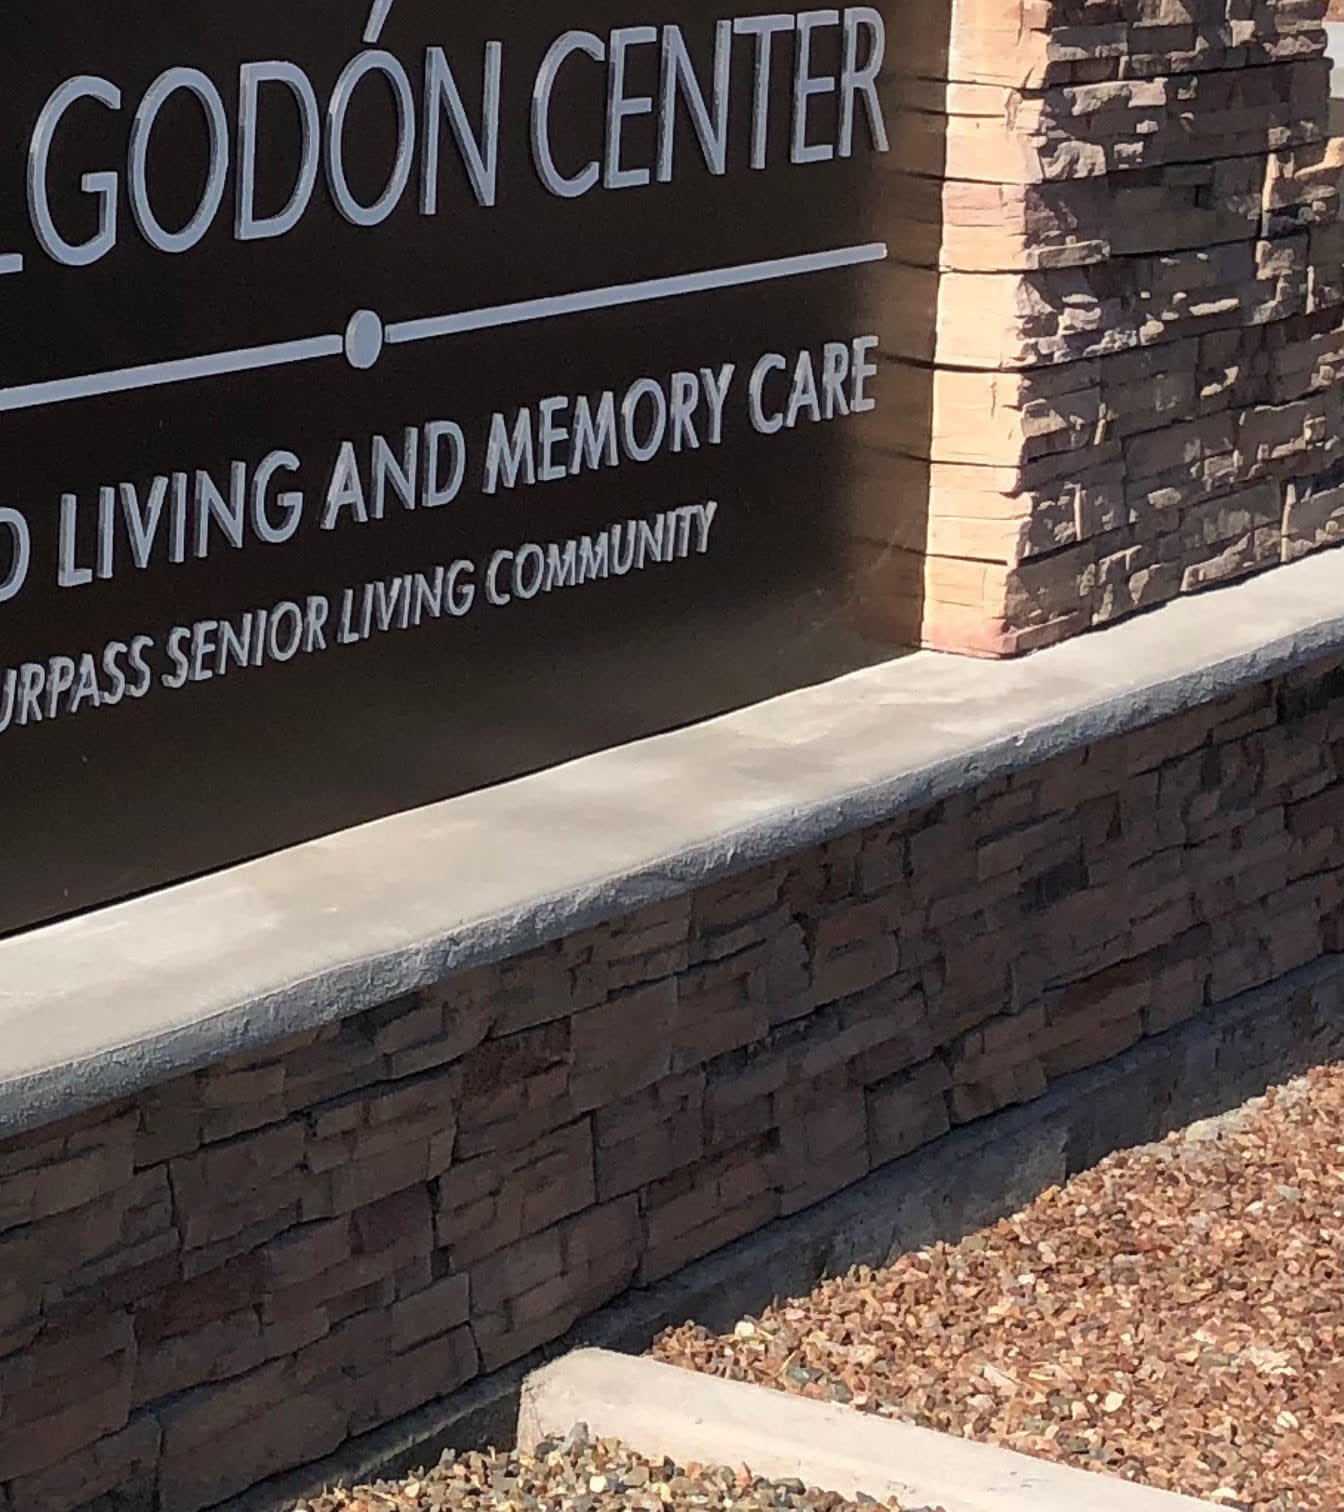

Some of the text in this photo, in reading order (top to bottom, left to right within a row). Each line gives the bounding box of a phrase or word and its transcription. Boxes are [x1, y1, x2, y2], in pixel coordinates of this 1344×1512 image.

[532, 6, 891, 199] CENTER
[57, 449, 304, 588] LIVING
[321, 419, 467, 531] AND
[484, 362, 736, 495] MEMORY
[748, 334, 880, 435] CARE
[160, 594, 330, 689] SENIOR
[341, 559, 476, 645] LIVING
[485, 500, 719, 606] COMMUNITY
